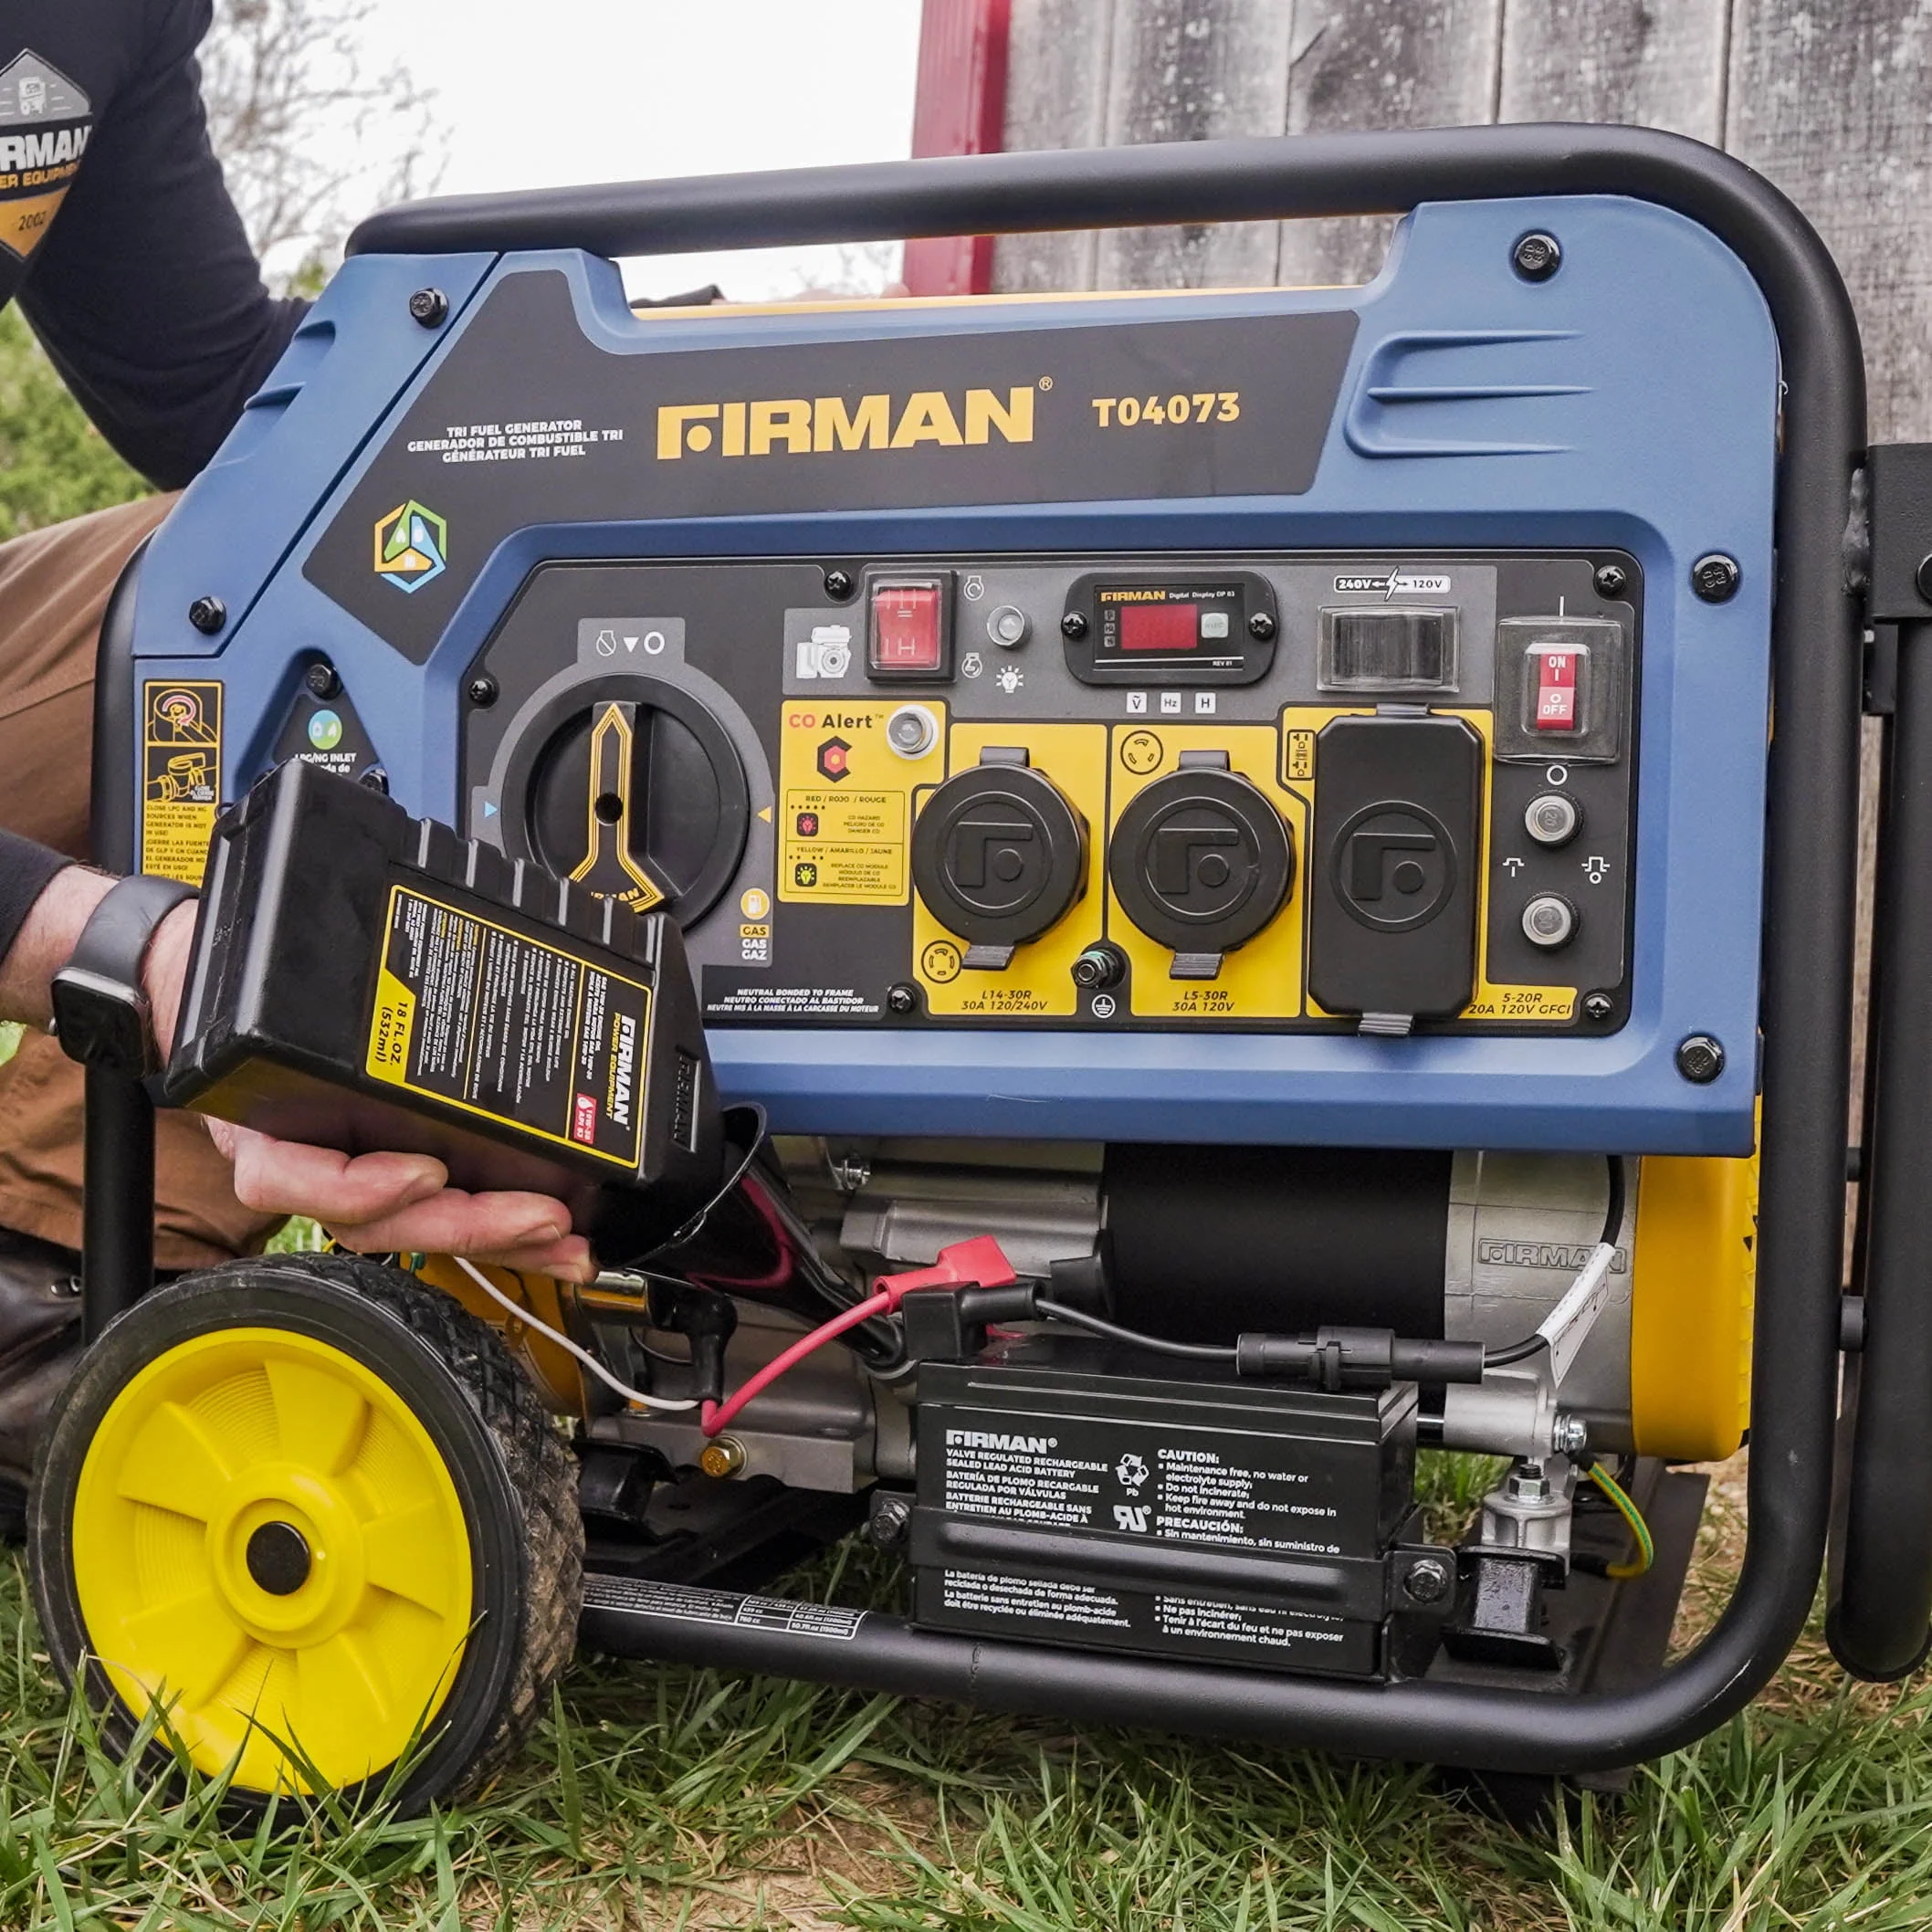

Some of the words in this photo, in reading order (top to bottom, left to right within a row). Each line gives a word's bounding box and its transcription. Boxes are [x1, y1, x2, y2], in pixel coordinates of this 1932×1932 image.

[1092, 392, 1240, 427] T04073
[446, 426, 467, 437] TRI
[470, 425, 501, 436] FUEL
[505, 420, 582, 435] GENERATOR
[407, 436, 485, 452] GENERADOR
[488, 436, 505, 447] DE
[509, 431, 598, 446] COMBUSTIBLE
[602, 430, 624, 440] TRI
[443, 447, 525, 463] GÉNÉRATEUR
[530, 447, 550, 458] TRI
[553, 445, 585, 457] FUEL
[1338, 578, 1372, 590] 240V
[1412, 579, 1443, 588] 120V
[1101, 591, 1166, 602] FIRMAN
[1549, 656, 1566, 668] ON
[1164, 698, 1178, 708] Hz
[1202, 698, 1210, 708] H
[1543, 705, 1568, 715] OFF
[789, 714, 816, 729] CO
[330, 752, 357, 762] INLET
[338, 763, 351, 773] de
[743, 927, 766, 936] GAS
[742, 939, 766, 949] GAS
[741, 950, 767, 961] GAZ
[822, 997, 864, 1005] BASTIDOR
[982, 990, 1032, 1001] L14-30R
[1183, 991, 1228, 1001] L5-30R
[1502, 993, 1542, 1003] 5-20R
[396, 1000, 407, 1018] 18
[961, 1001, 985, 1011] 30A
[990, 1000, 1048, 1012] 120/240V
[1172, 1002, 1197, 1012] 30A
[1202, 1002, 1235, 1012] 120V
[1468, 1004, 1496, 1014] 20A
[1501, 1004, 1536, 1015] 120V
[1538, 1004, 1571, 1015] GFCI
[374, 1005, 393, 1064] (532ml)
[611, 1013, 621, 1052] POWER
[605, 1052, 617, 1119] EQUIPMENT
[946, 1448, 975, 1459] VALVE
[978, 1452, 1031, 1464] REGULATED
[1034, 1456, 1108, 1471] RECHARGEABLE
[1158, 1449, 1219, 1464] CAUTION:
[946, 1458, 982, 1469] SEALED
[983, 1462, 1007, 1472] LEAD
[1009, 1465, 1032, 1474] ACID
[1034, 1466, 1076, 1478] BATTERY
[1166, 1463, 1227, 1475] Maintenance
[1229, 1467, 1251, 1478] free,
[1253, 1471, 1265, 1479] no
[1267, 1473, 1297, 1482] water
[1297, 1475, 1308, 1483] or
[946, 1471, 985, 1482] BATERÍA
[988, 1475, 1000, 1484] DE
[1003, 1476, 1035, 1487] PLOMO
[1037, 1479, 1099, 1494] RECARGABLE
[1166, 1472, 1216, 1486] electrolyte
[946, 1481, 995, 1493] REGULADA
[998, 1486, 1016, 1495] POR
[1019, 1486, 1066, 1500] VÁLVULAS
[1127, 1488, 1139, 1496] Pb
[1166, 1483, 1180, 1492] Do
[1181, 1485, 1198, 1494] not
[946, 1492, 989, 1504] BATTERIE
[992, 1496, 1065, 1511] RECHARGEABLE
[1066, 1504, 1092, 1514] SANS
[1165, 1493, 1191, 1505] Keep
[1192, 1495, 1208, 1505] fire
[1210, 1498, 1235, 1508] away
[1236, 1501, 1255, 1509] and
[1257, 1502, 1270, 1511] do
[1272, 1504, 1289, 1512] not
[1290, 1506, 1325, 1516] expose
[1327, 1507, 1337, 1517] in
[1165, 1503, 1181, 1513] hot
[946, 1501, 996, 1514] ENTRETIEN
[998, 1507, 1012, 1516] AU
[1013, 1507, 1079, 1522] PLOMB-ACIDE
[1157, 1516, 1244, 1534] PRECAUCIÓN:
[1164, 1528, 1180, 1538] Sin
[1181, 1530, 1256, 1547] mantenimiento,
[1258, 1538, 1272, 1547] sin
[1274, 1539, 1325, 1552] suministro
[1327, 1544, 1340, 1553] de
[944, 1579, 981, 1591] reciclada
[990, 1583, 1033, 1596] desechada
[1034, 1588, 1045, 1598] de
[1047, 1590, 1073, 1601] forma
[944, 1590, 954, 1598] La
[956, 1591, 989, 1602] batterie
[991, 1596, 1009, 1604] sans
[1012, 1598, 1049, 1610] entretien
[1051, 1602, 1062, 1611] au
[1163, 1605, 1177, 1613] Ne
[1179, 1608, 1195, 1616] pas
[1162, 1625, 1169, 1633] à
[1171, 1627, 1182, 1635] un
[1184, 1629, 1256, 1643] environnement
[1163, 1615, 1186, 1626] Tenir
[1188, 1618, 1194, 1626] à
[1227, 1622, 1240, 1631] du
[1242, 1622, 1258, 1633] feu
[1260, 1625, 1270, 1634] et
[1272, 1627, 1285, 1635] ne
[1286, 1629, 1304, 1638] pas
[1305, 1632, 1344, 1643] exposer
